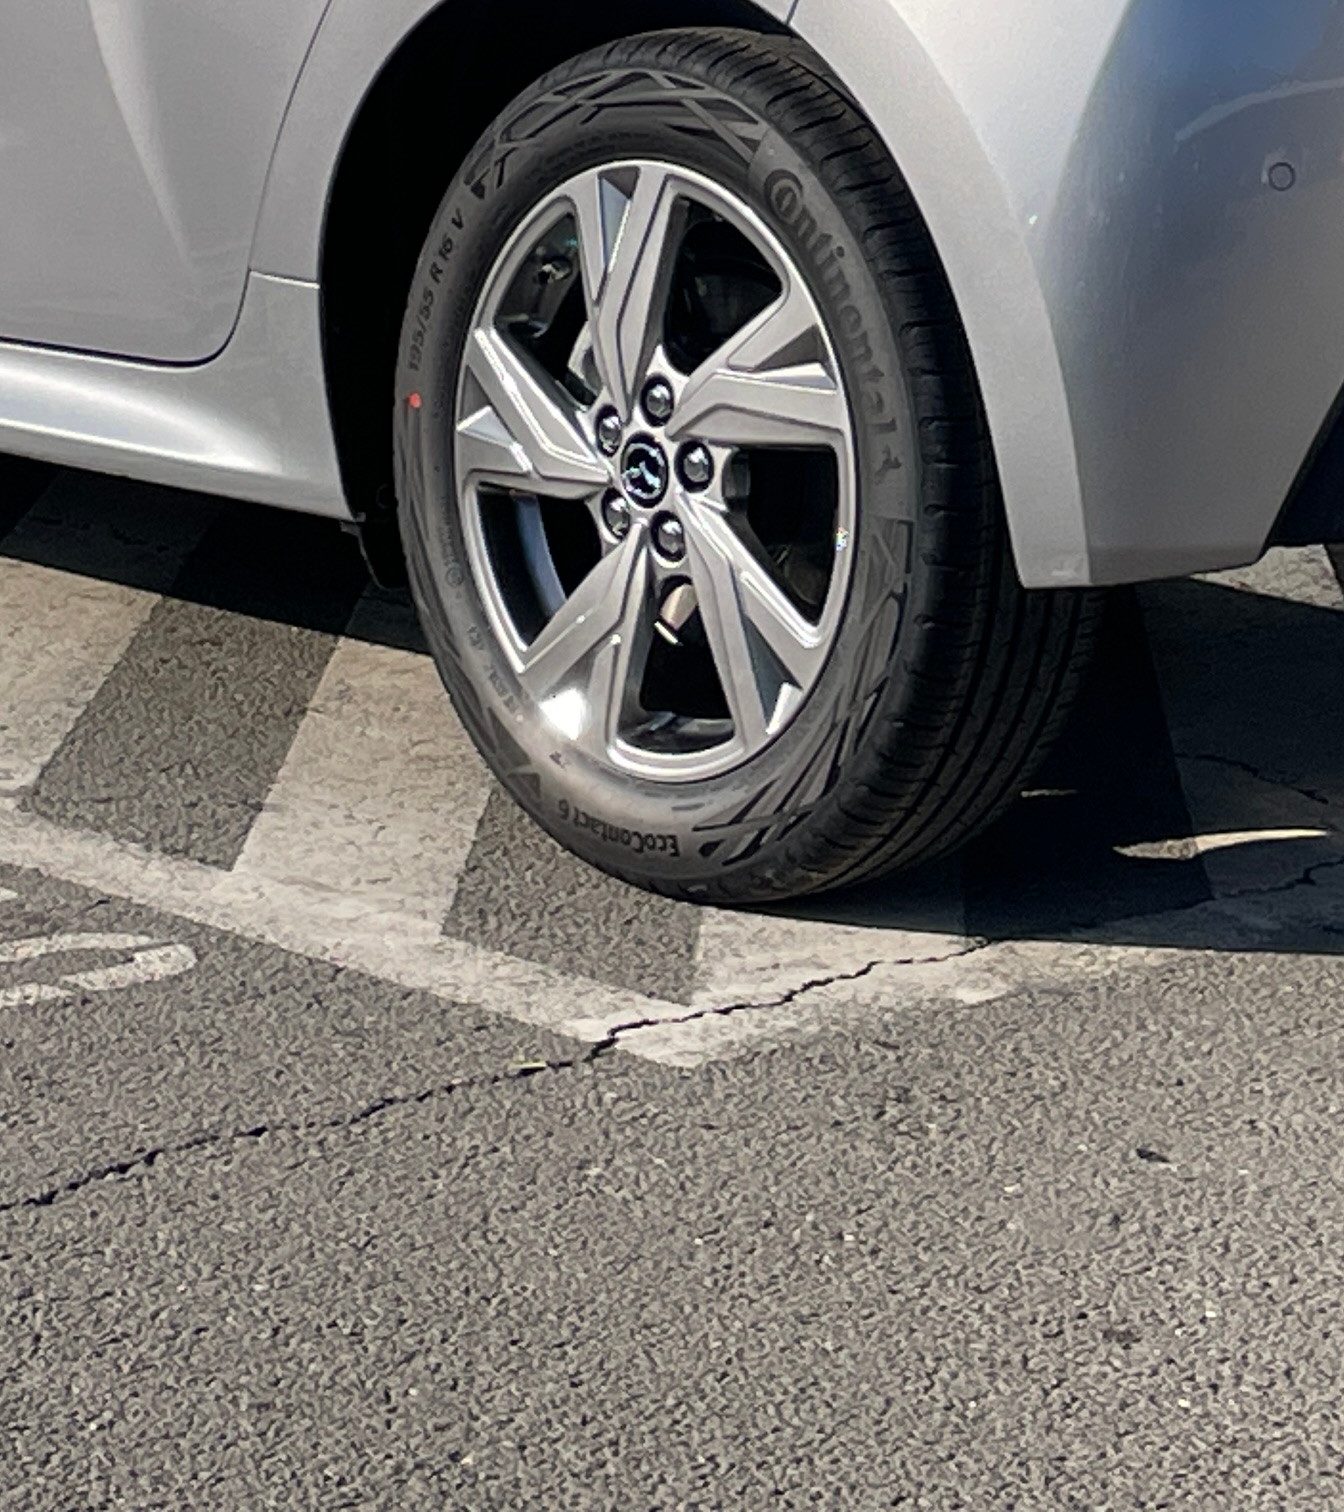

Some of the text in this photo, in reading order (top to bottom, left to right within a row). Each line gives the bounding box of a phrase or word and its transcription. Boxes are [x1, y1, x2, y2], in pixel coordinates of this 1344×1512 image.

[429, 261, 444, 284] R
[763, 168, 899, 433] Continental
[557, 797, 681, 858] EcoContact 6
